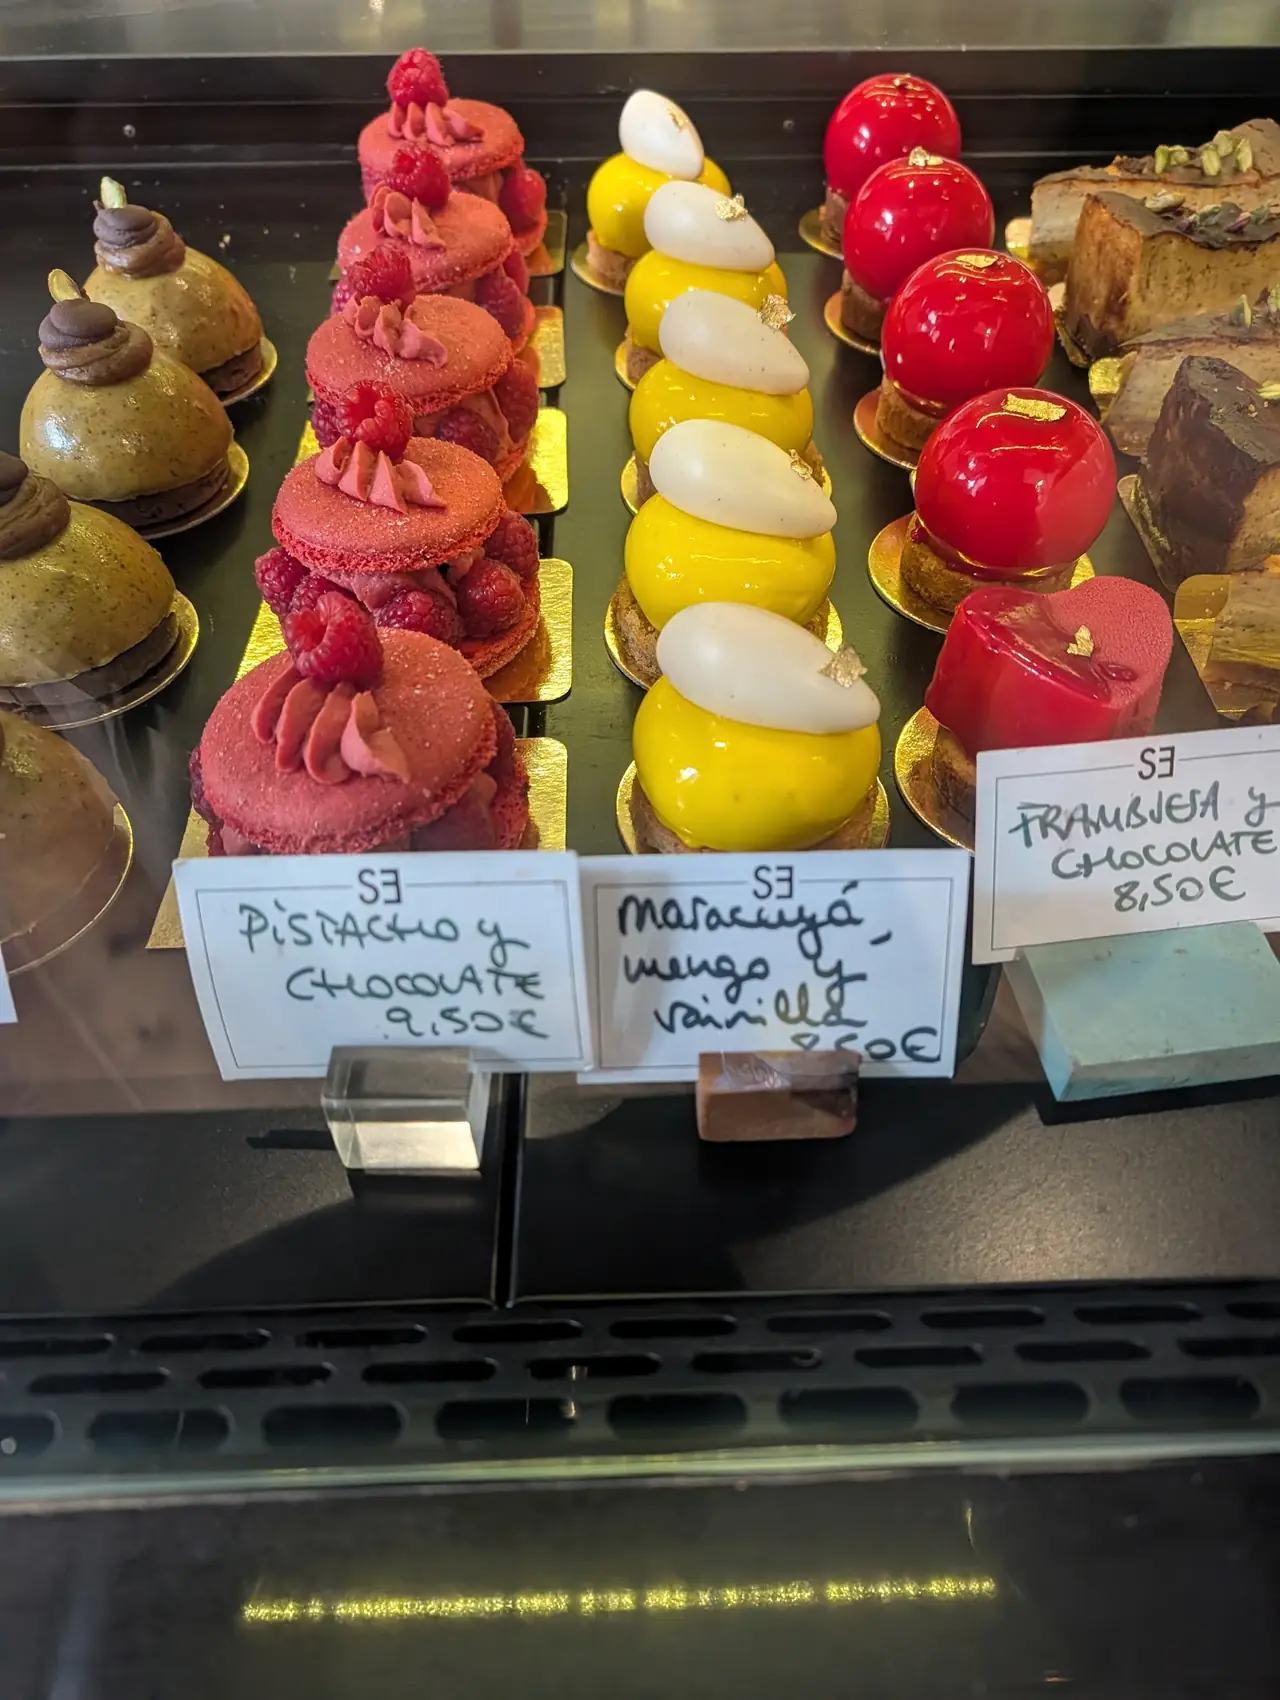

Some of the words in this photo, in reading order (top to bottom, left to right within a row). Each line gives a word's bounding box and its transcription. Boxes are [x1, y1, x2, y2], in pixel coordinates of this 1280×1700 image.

[1245, 787, 1280, 826] y
[1051, 830, 1278, 879] CHOCOLATE
[1114, 866, 1246, 912] 8,50€
[477, 919, 530, 967] y
[286, 966, 545, 1000] CHOCOLATE
